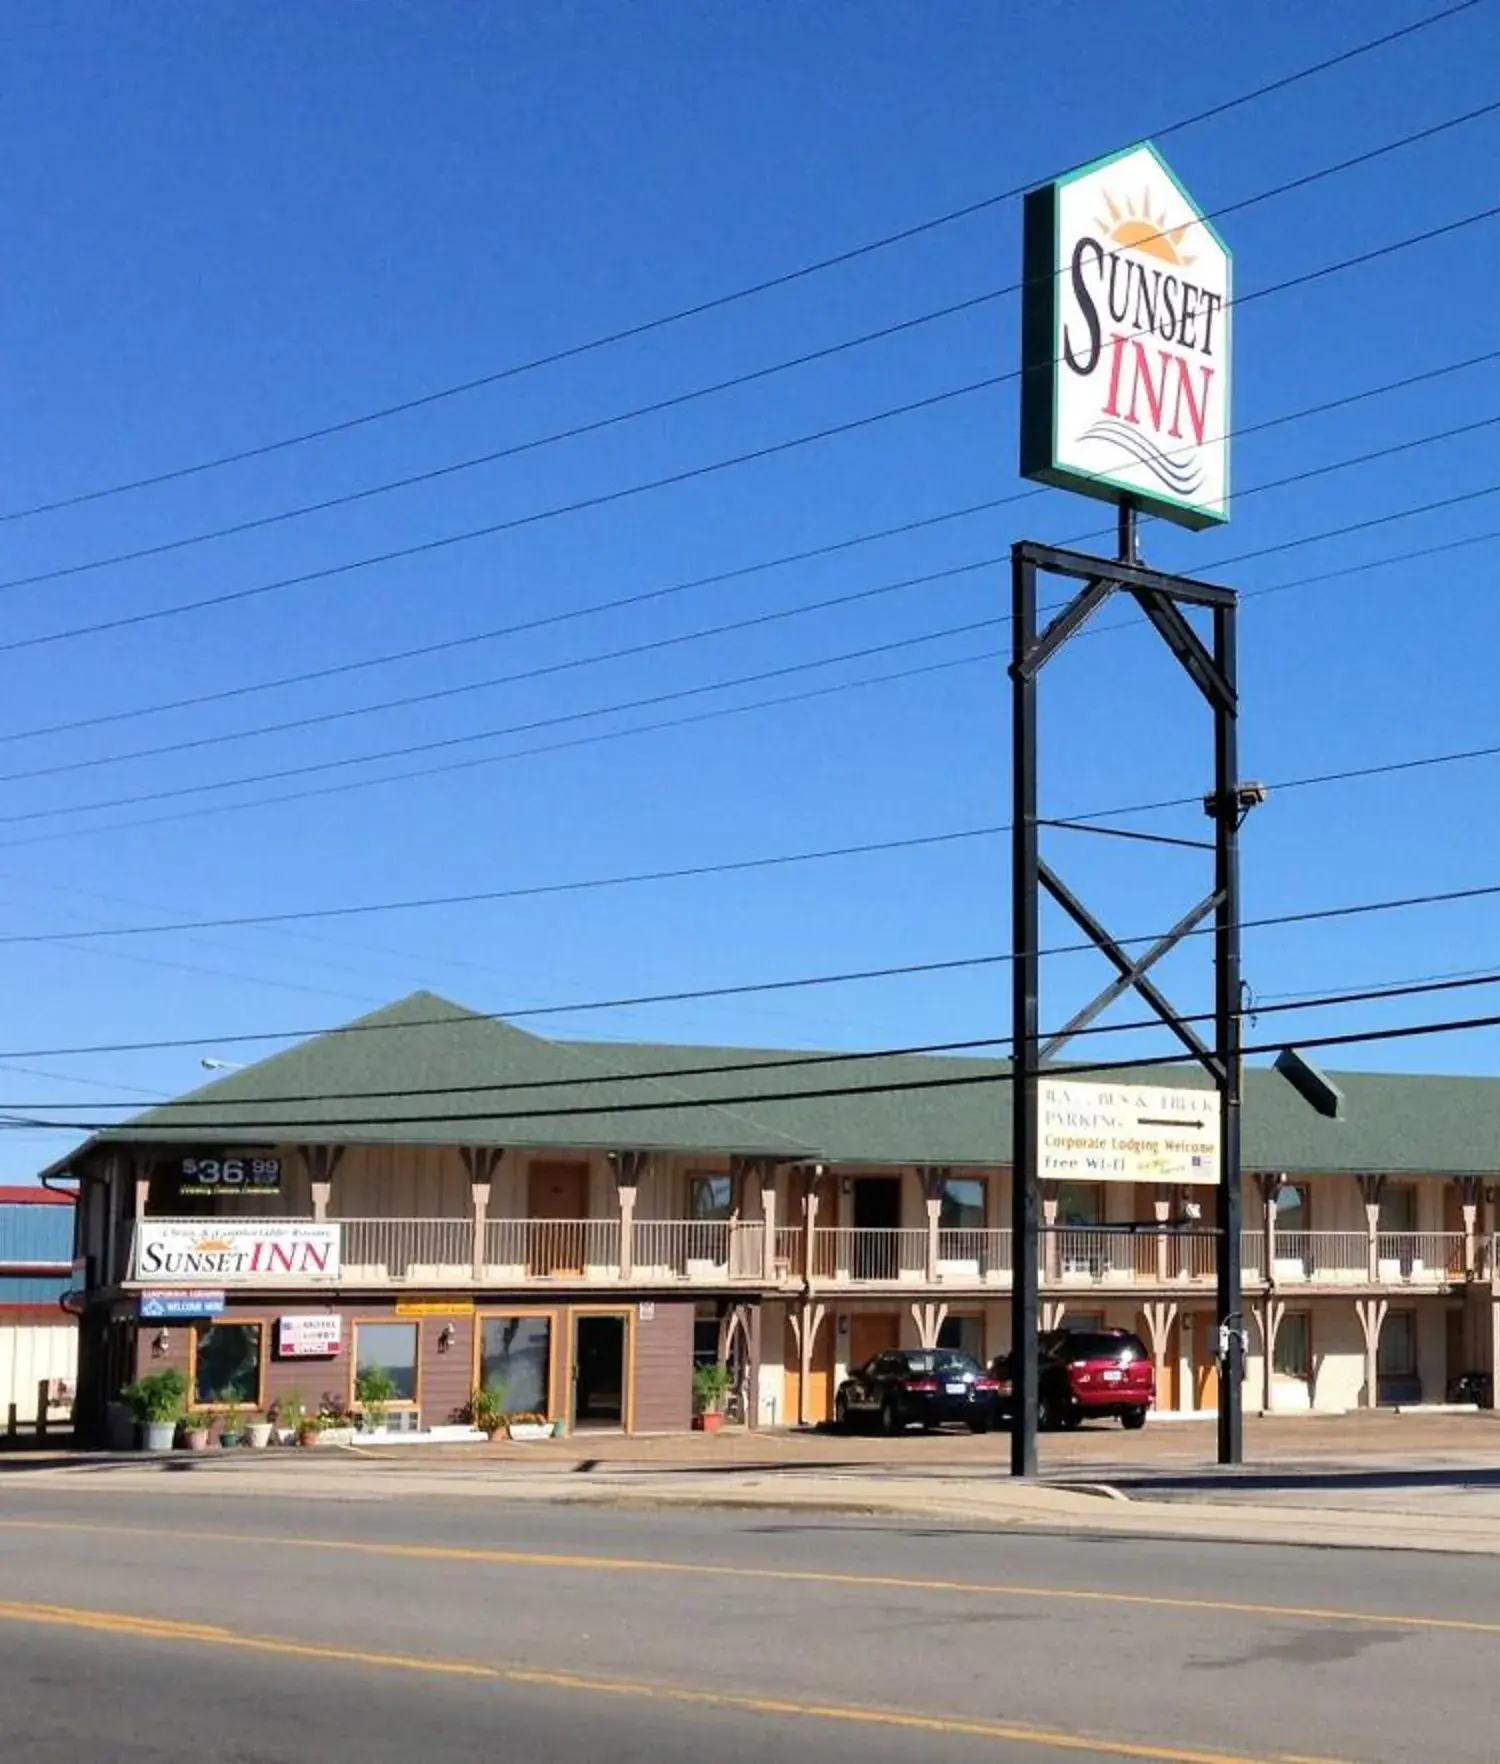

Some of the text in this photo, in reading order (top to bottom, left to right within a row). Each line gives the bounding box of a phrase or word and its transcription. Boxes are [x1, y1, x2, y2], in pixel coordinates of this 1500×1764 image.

[1064, 237, 1222, 376] SUNSET
[1102, 333, 1215, 446] INN
[1045, 1134, 1216, 1155] Corporate Lodging Welcome
[1045, 1155, 1079, 1169] Free
[142, 1240, 335, 1274] SUNSET INN
